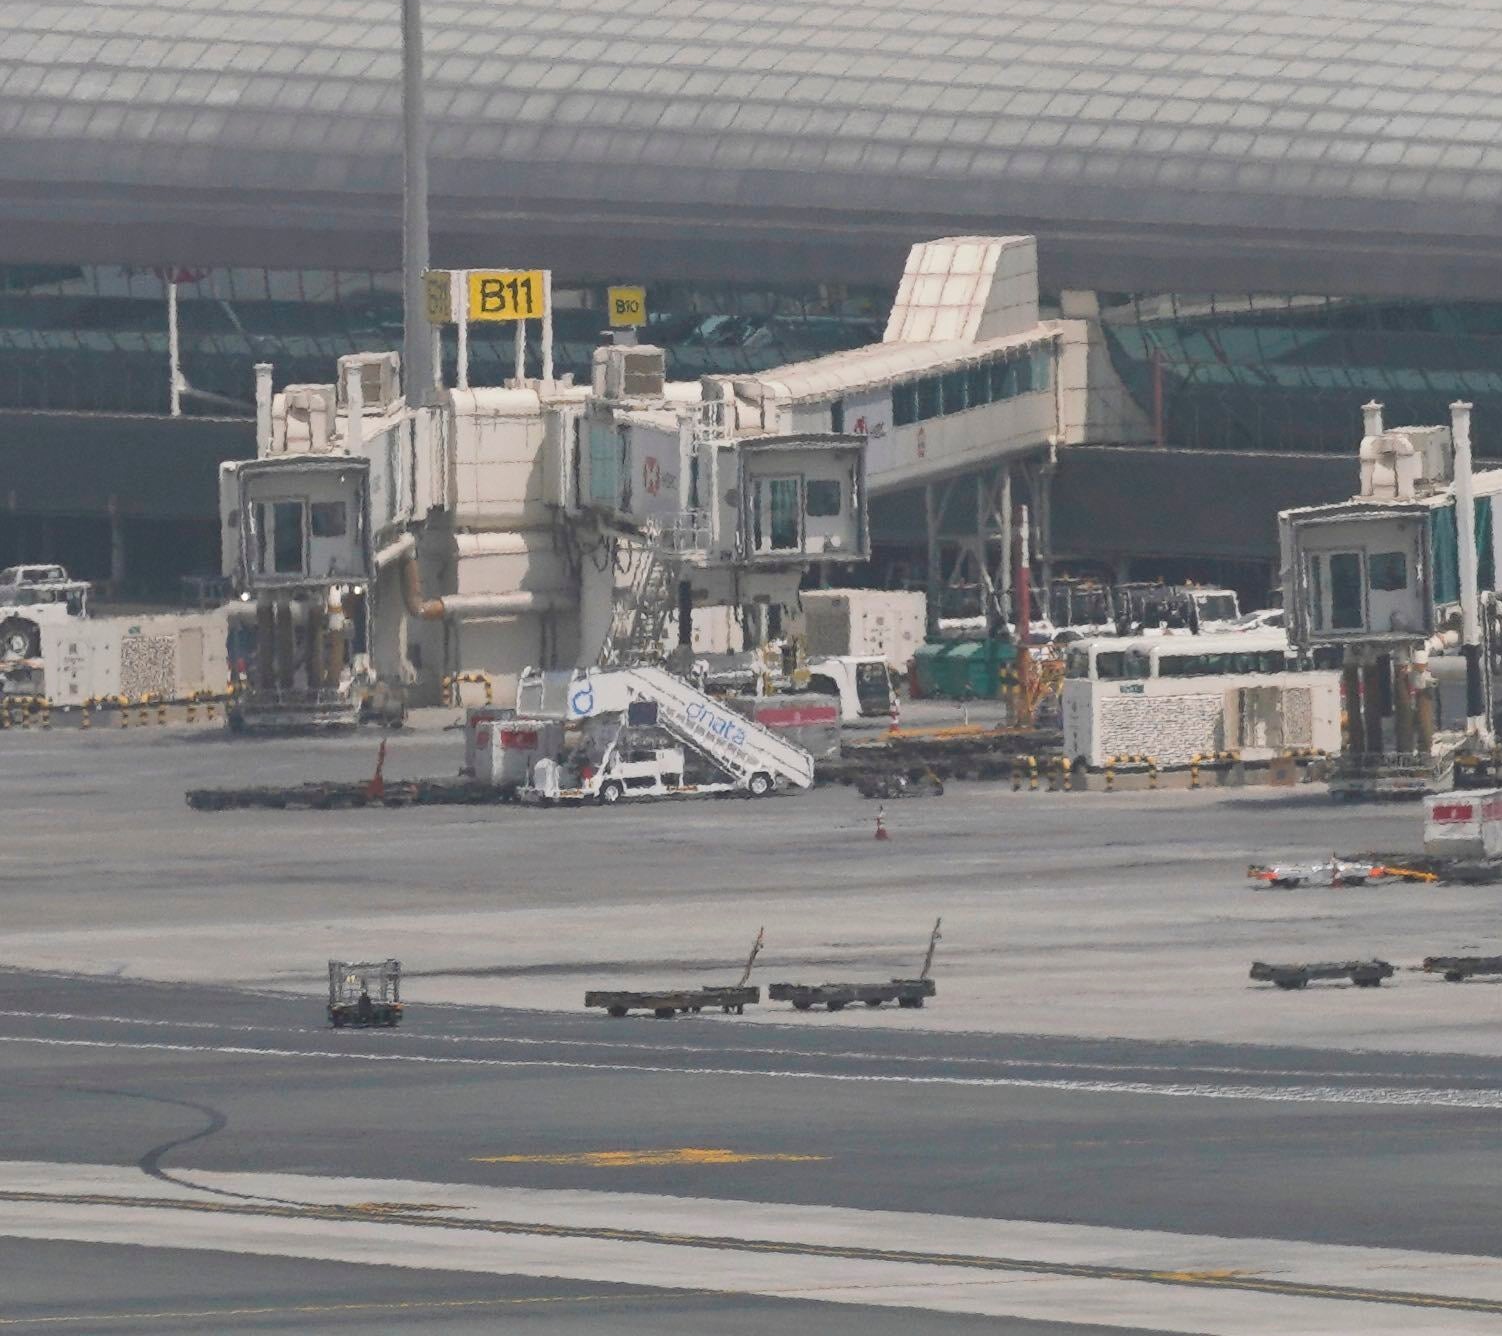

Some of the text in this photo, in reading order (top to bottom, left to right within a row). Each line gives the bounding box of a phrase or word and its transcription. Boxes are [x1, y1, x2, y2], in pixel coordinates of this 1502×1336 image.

[480, 277, 533, 314] B11
[615, 299, 639, 314] B10
[686, 702, 745, 746] dnata
